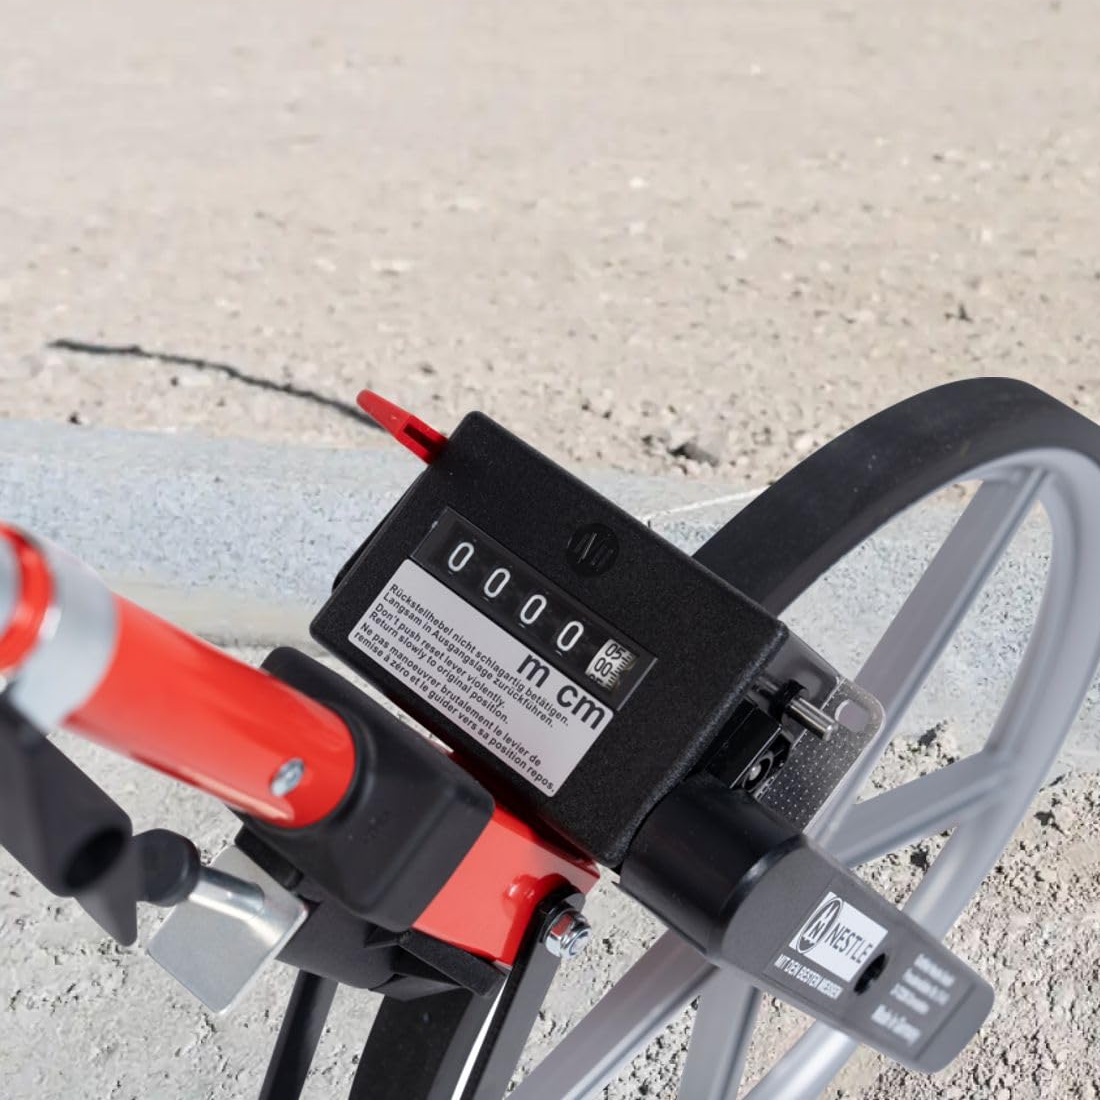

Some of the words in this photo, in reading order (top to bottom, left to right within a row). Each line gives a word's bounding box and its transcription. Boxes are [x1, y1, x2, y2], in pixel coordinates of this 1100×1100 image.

[353, 631, 383, 657] remise
[383, 653, 390, 662] à
[389, 659, 409, 677] zéro
[409, 675, 420, 685] et
[418, 680, 428, 692] le
[427, 690, 458, 714] guider
[457, 711, 477, 730] vers
[477, 728, 489, 740] sa
[487, 737, 526, 769] position
[525, 766, 554, 792] repos.
[360, 622, 372, 635] Ne
[371, 633, 389, 648] pas
[388, 646, 441, 687] manoeuvrer
[440, 684, 494, 729] brutalement
[492, 724, 502, 736] le
[502, 732, 529, 756] levier
[528, 754, 541, 766] de
[368, 610, 399, 637] Return
[397, 634, 427, 659] slowly
[426, 655, 436, 667] to
[436, 664, 472, 693] original
[468, 690, 507, 724] position.
[374, 602, 399, 625] Don't
[396, 622, 421, 642] push
[420, 639, 444, 660] reset
[443, 655, 466, 676] lever
[466, 674, 505, 708] violently.
[383, 591, 422, 626] Langsam
[421, 621, 431, 633] in
[430, 629, 493, 679] Ausgangslage
[492, 674, 552, 727] zurückführen.
[388, 583, 453, 635] Rückstellhebel
[451, 633, 476, 653] nicht
[474, 650, 525, 693] schlagartig
[522, 686, 568, 726] betätigen.
[516, 653, 550, 688] m
[556, 684, 605, 730] cm
[774, 953, 791, 969] MIT
[783, 959, 802, 976] DEN
[795, 966, 822, 987] BESTEN
[824, 922, 873, 966] NESTLE
